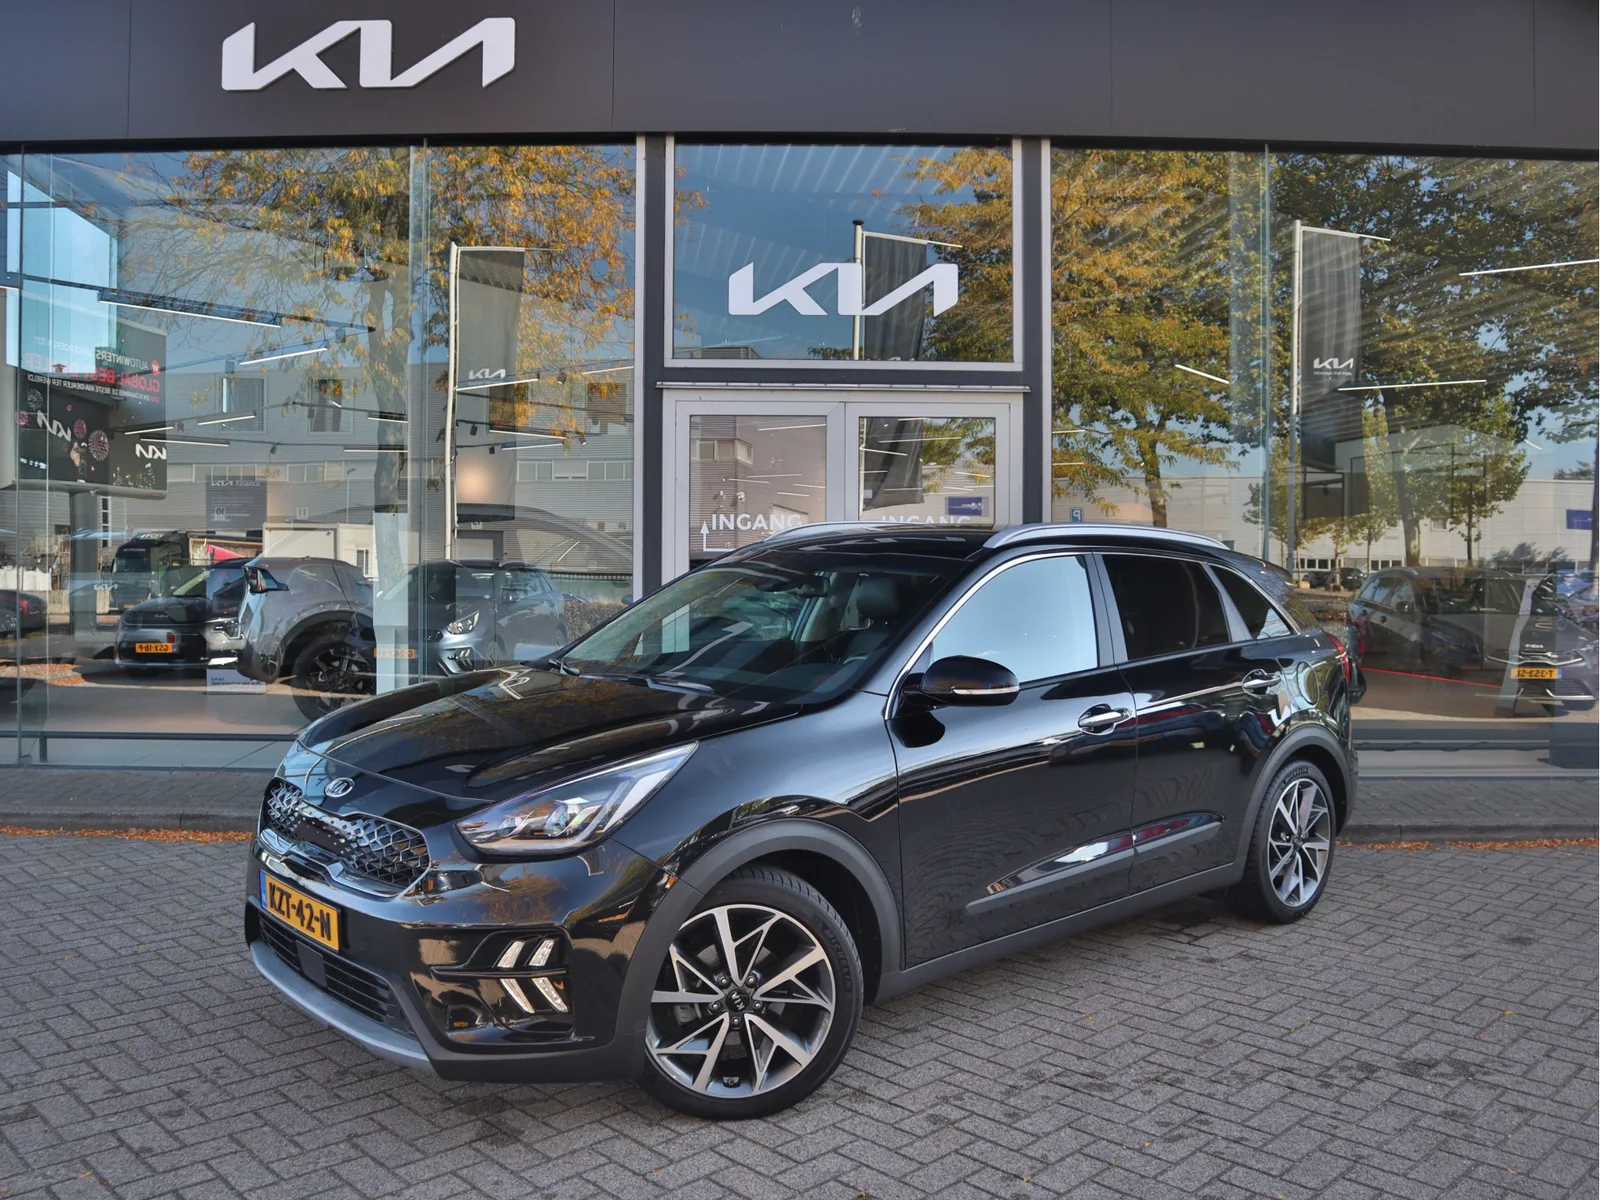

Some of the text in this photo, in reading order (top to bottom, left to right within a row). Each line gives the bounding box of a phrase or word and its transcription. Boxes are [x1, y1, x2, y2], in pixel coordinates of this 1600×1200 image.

[221, 17, 516, 91] KIA
[728, 262, 959, 317] KIA
[1313, 357, 1354, 369] KIA
[468, 368, 506, 380] KIA
[712, 513, 802, 530] INGANG
[268, 882, 332, 942] KZT-42-N
[731, 991, 745, 1010] KIA
